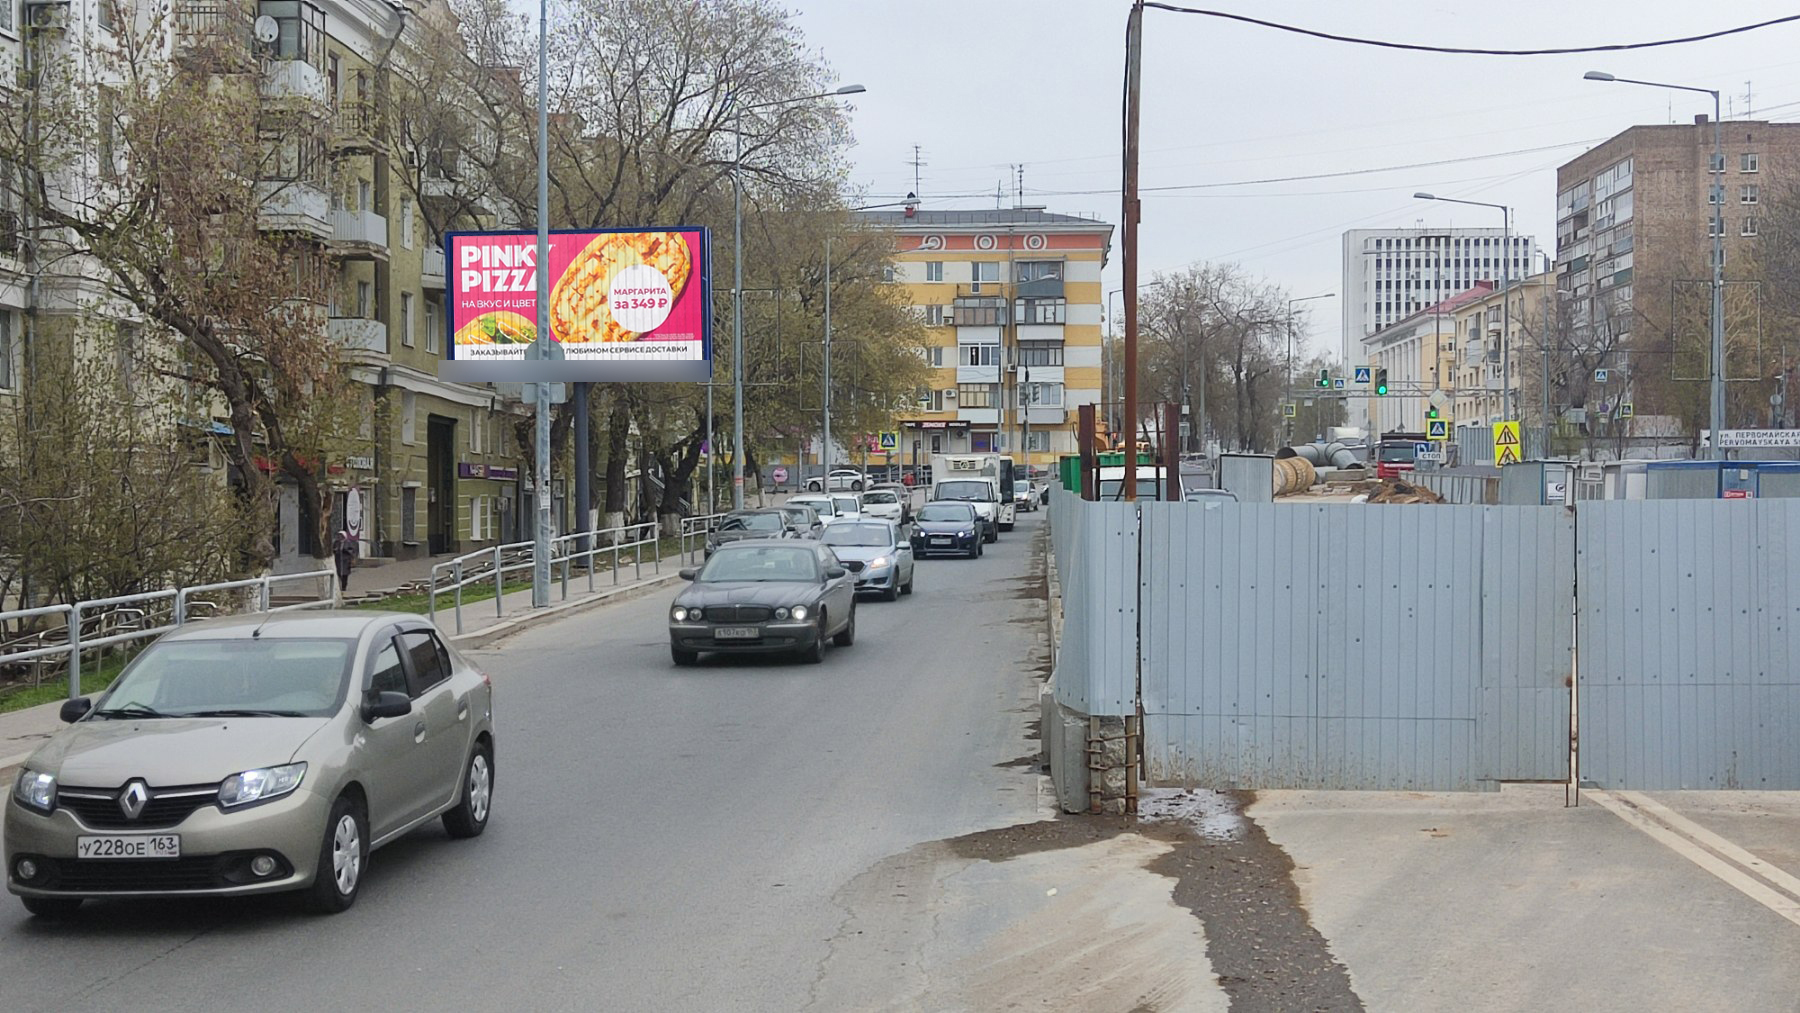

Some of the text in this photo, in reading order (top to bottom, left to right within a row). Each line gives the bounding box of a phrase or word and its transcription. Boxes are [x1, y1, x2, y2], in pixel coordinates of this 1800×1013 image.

[614, 287, 667, 295] МАРГАРИТА
[461, 299, 536, 308] НА ВКУС И ЦВЕТ
[614, 300, 629, 309] за
[631, 298, 656, 309] 349
[470, 345, 688, 356] ЗАКАЗЫВАЙТ ЛЮБИМОМ СЕРВИСЕ ДОСТАВКИ
[1720, 438, 1790, 446] PERVOMAYSKAYA
[150, 837, 175, 851] 163
